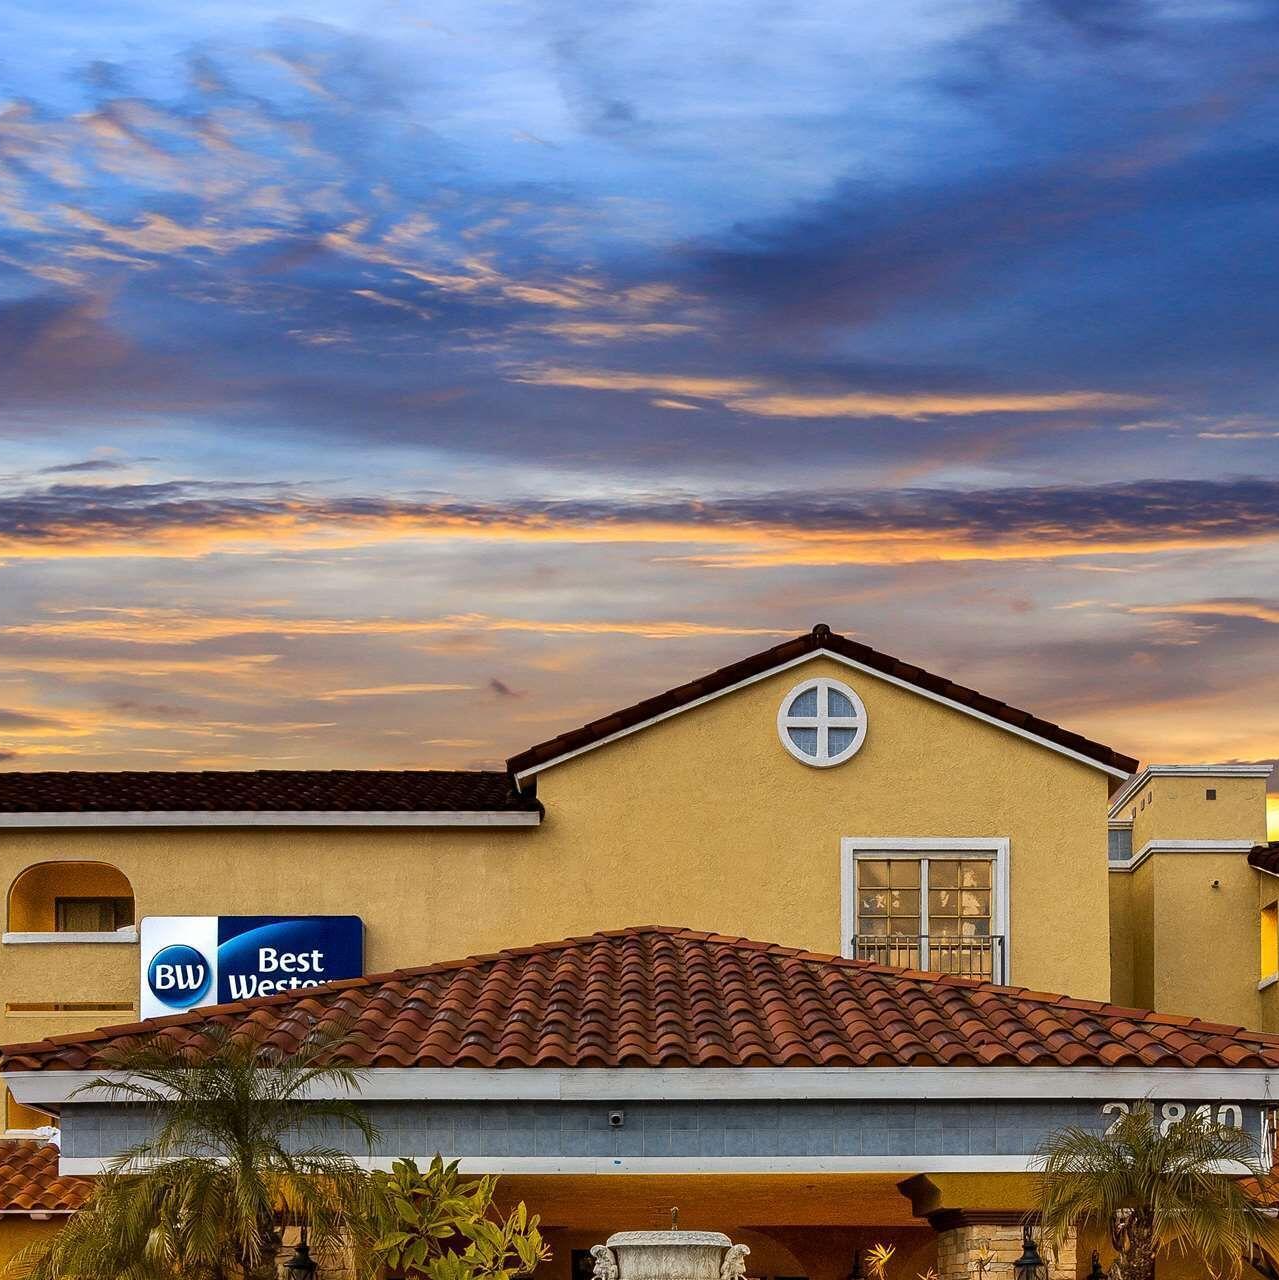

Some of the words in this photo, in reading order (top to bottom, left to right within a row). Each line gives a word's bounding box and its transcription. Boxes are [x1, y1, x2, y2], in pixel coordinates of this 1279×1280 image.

[259, 947, 324, 973] Best
[155, 964, 205, 990] BW
[228, 974, 335, 1000] West
[1102, 1102, 1243, 1141] 2840
